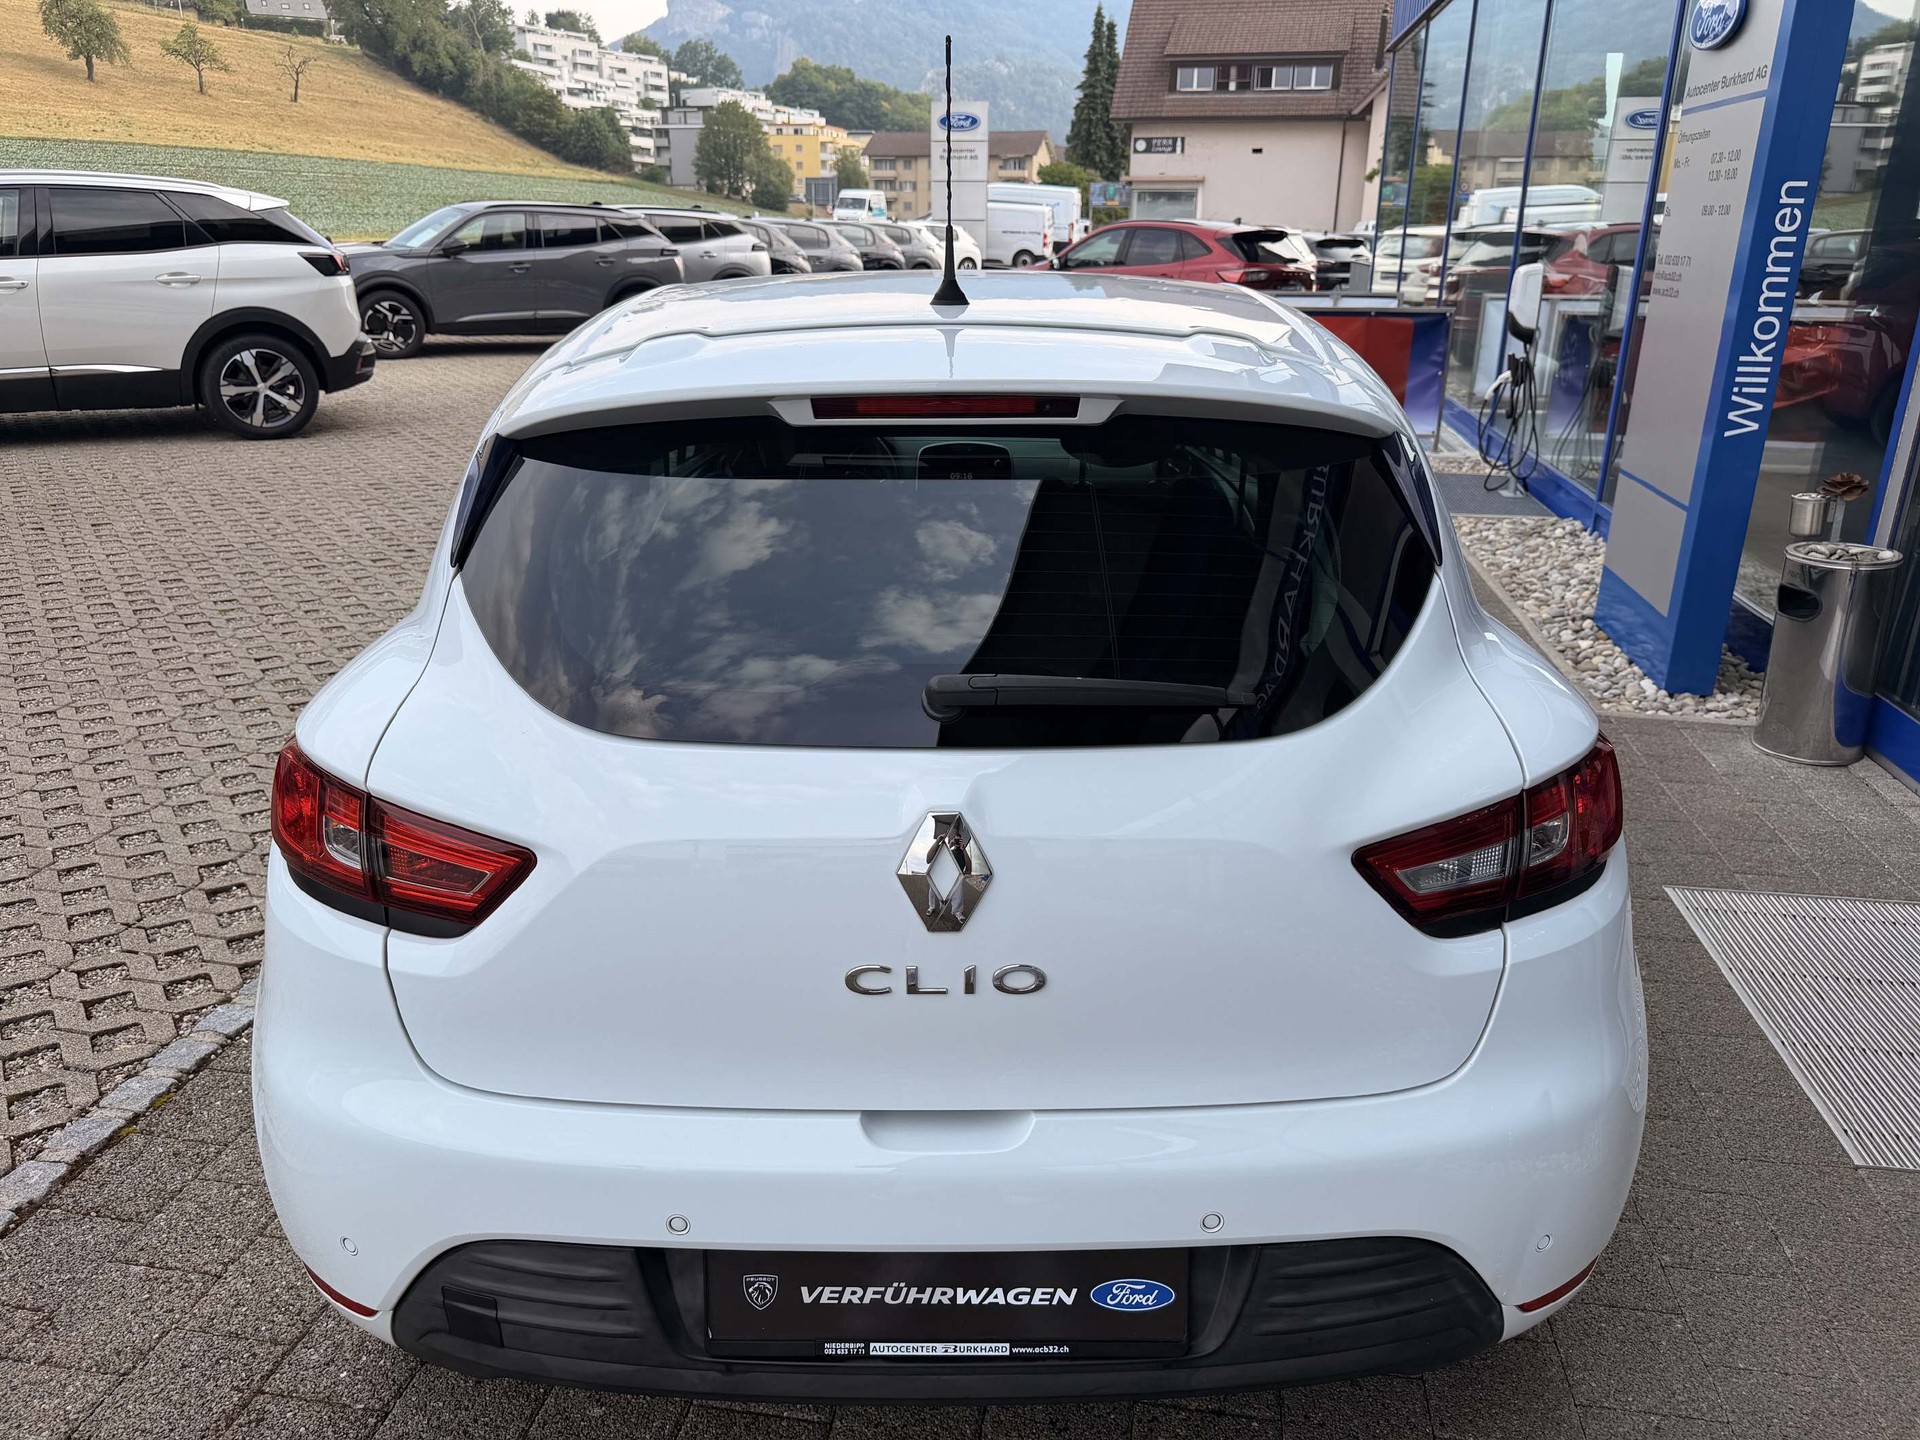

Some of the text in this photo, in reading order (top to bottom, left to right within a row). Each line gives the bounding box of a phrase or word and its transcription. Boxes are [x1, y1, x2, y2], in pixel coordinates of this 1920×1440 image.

[1685, 64, 1768, 99] Autocenter Burkhard AG
[1727, 149, 1742, 162] 12.00
[1724, 181, 1808, 437] Willkommen
[950, 472, 973, 480] 09:16
[845, 964, 1047, 995] CLIO
[800, 1282, 1078, 1306] VERFÜHRWAGEN
[1106, 1283, 1159, 1306] Ford
[871, 1344, 1008, 1354] AUTOCENTER BURKHARD
[1011, 1345, 1069, 1354] www.acb32.ch
